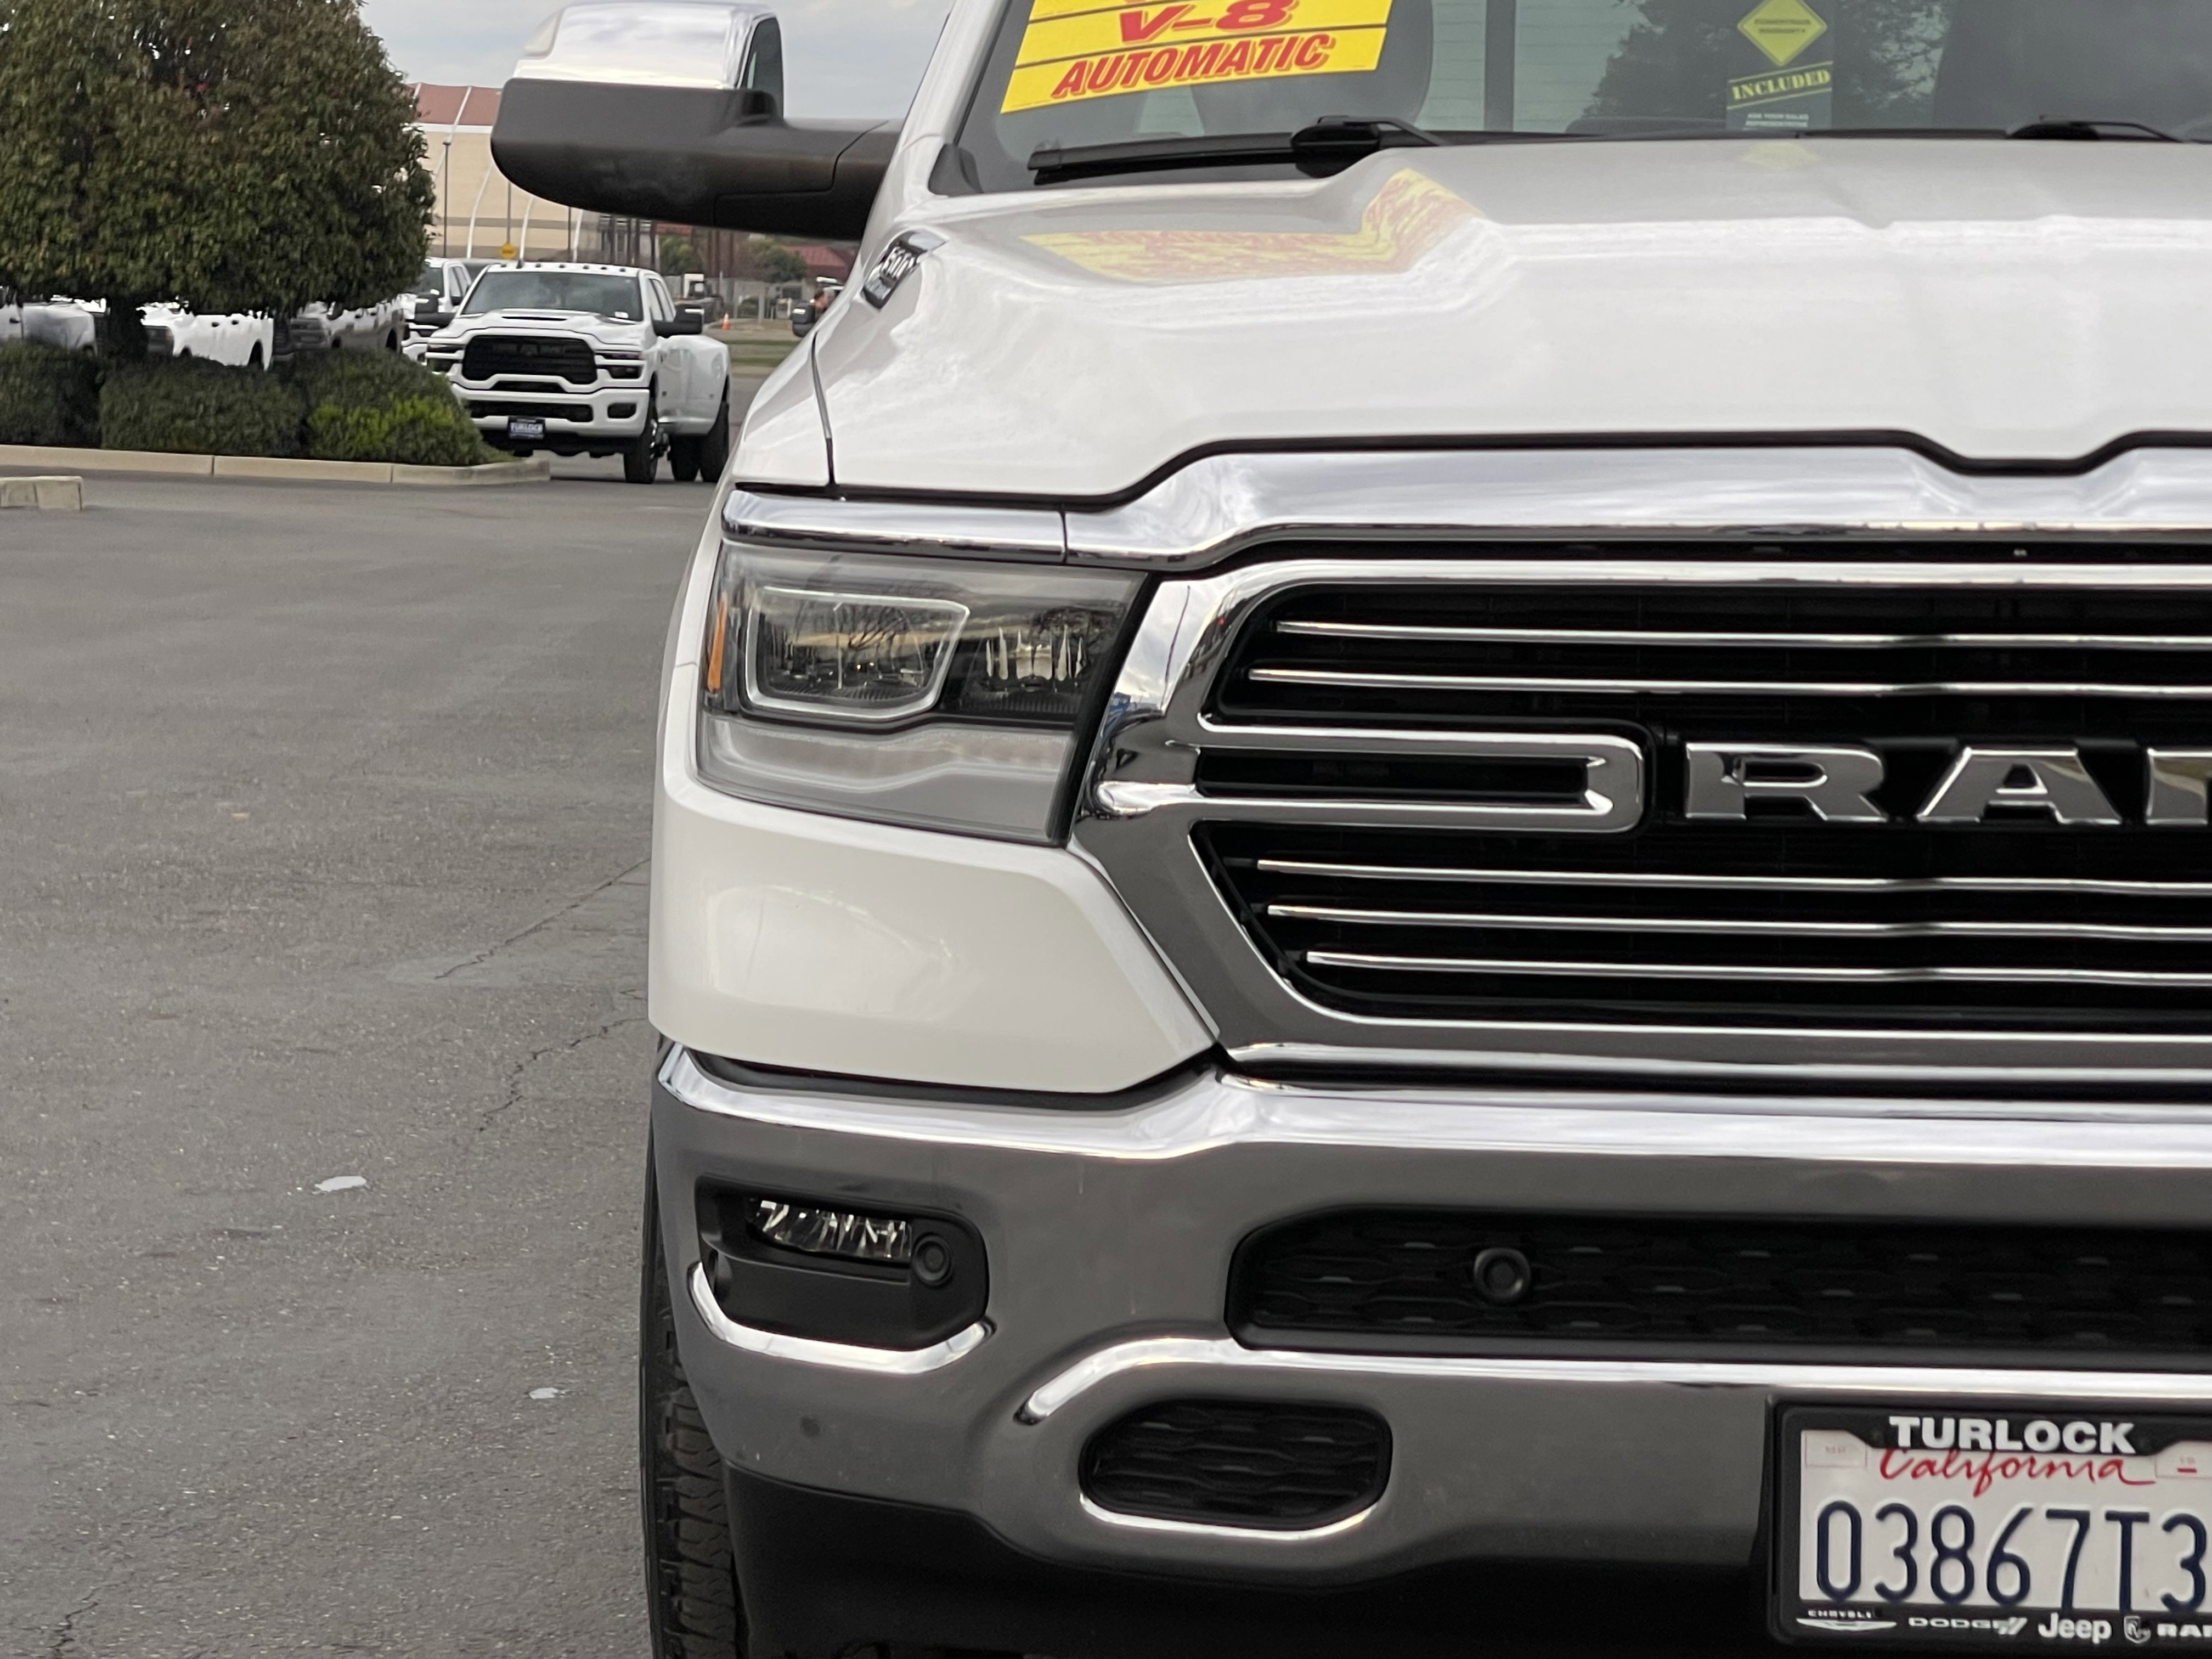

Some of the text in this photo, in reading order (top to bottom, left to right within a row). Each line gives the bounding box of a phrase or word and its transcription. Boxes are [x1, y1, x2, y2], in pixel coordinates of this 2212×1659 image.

[1119, 0, 1296, 44] V-8
[1051, 33, 1335, 99] AUTOMATIC
[1731, 69, 1831, 100] INCLUDED
[1888, 1415, 2136, 1454] TURLOCK
[1878, 1448, 2157, 1498] California
[1816, 1500, 2208, 1613] 03867T3
[2038, 1612, 2112, 1644] Jeep
